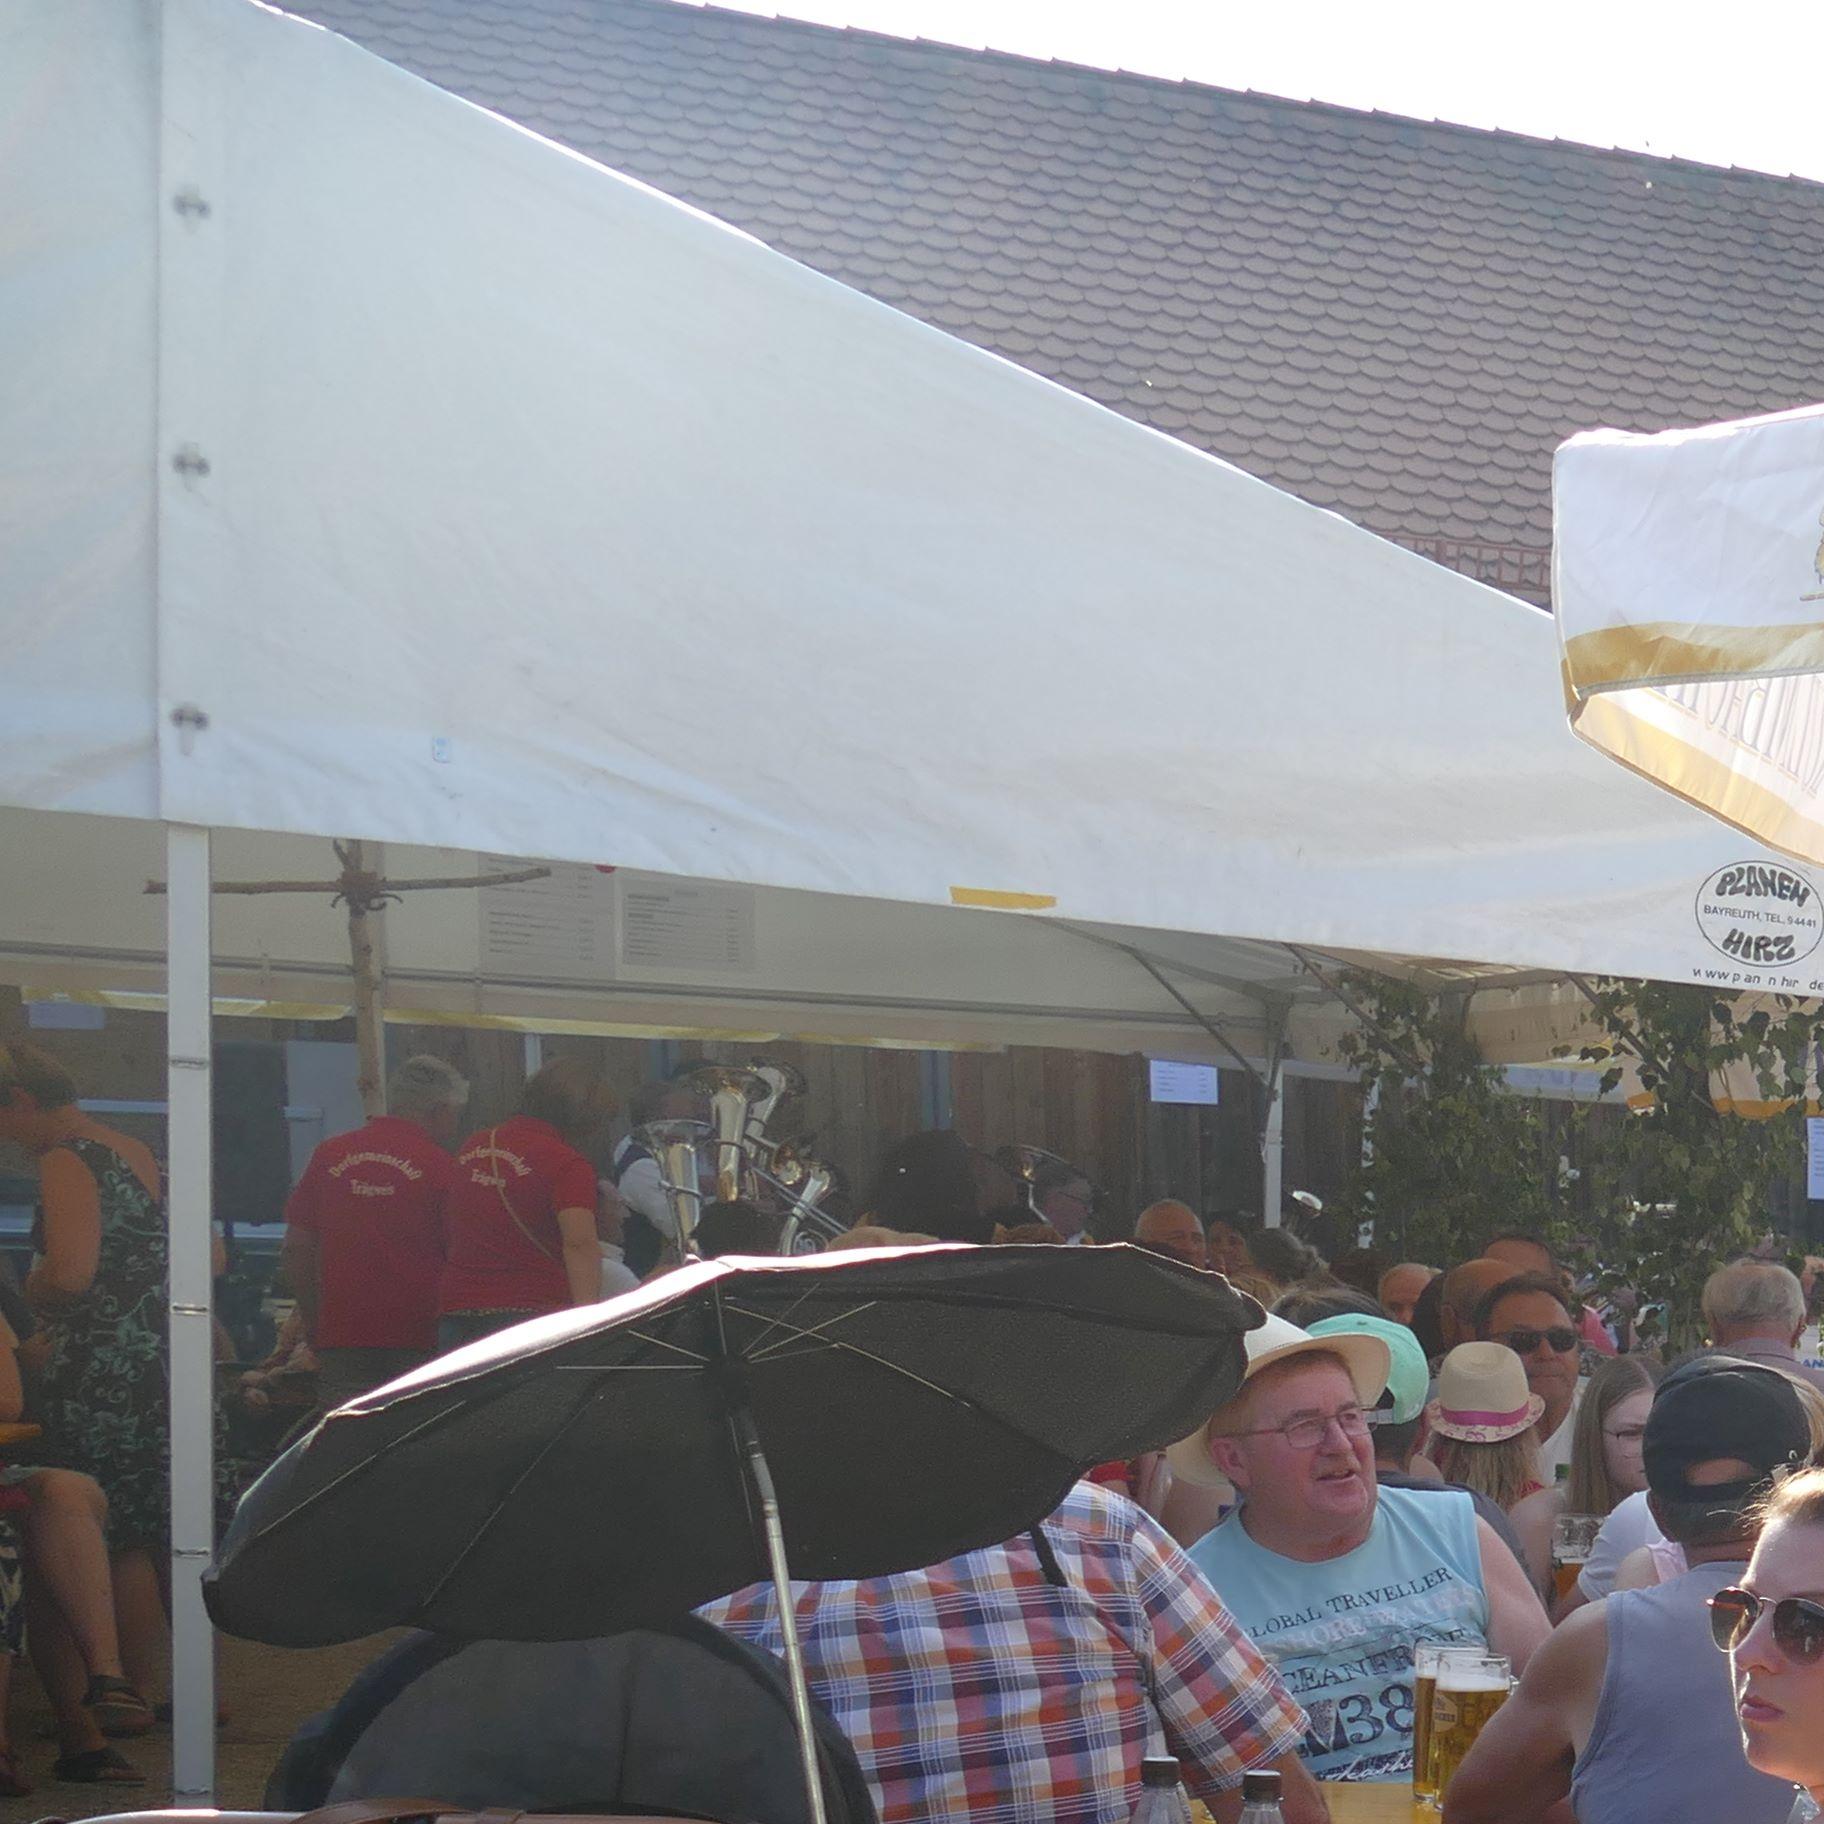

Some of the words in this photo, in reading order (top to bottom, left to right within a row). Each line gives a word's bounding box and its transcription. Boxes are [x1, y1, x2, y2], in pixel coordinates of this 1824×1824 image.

[1715, 866, 1811, 908] PLANEN
[1703, 904, 1762, 922] BAYREUTH,
[1787, 914, 1817, 928] 94441
[1722, 928, 1796, 962] HIRZ
[1326, 1566, 1453, 1614] TRAVELLER
